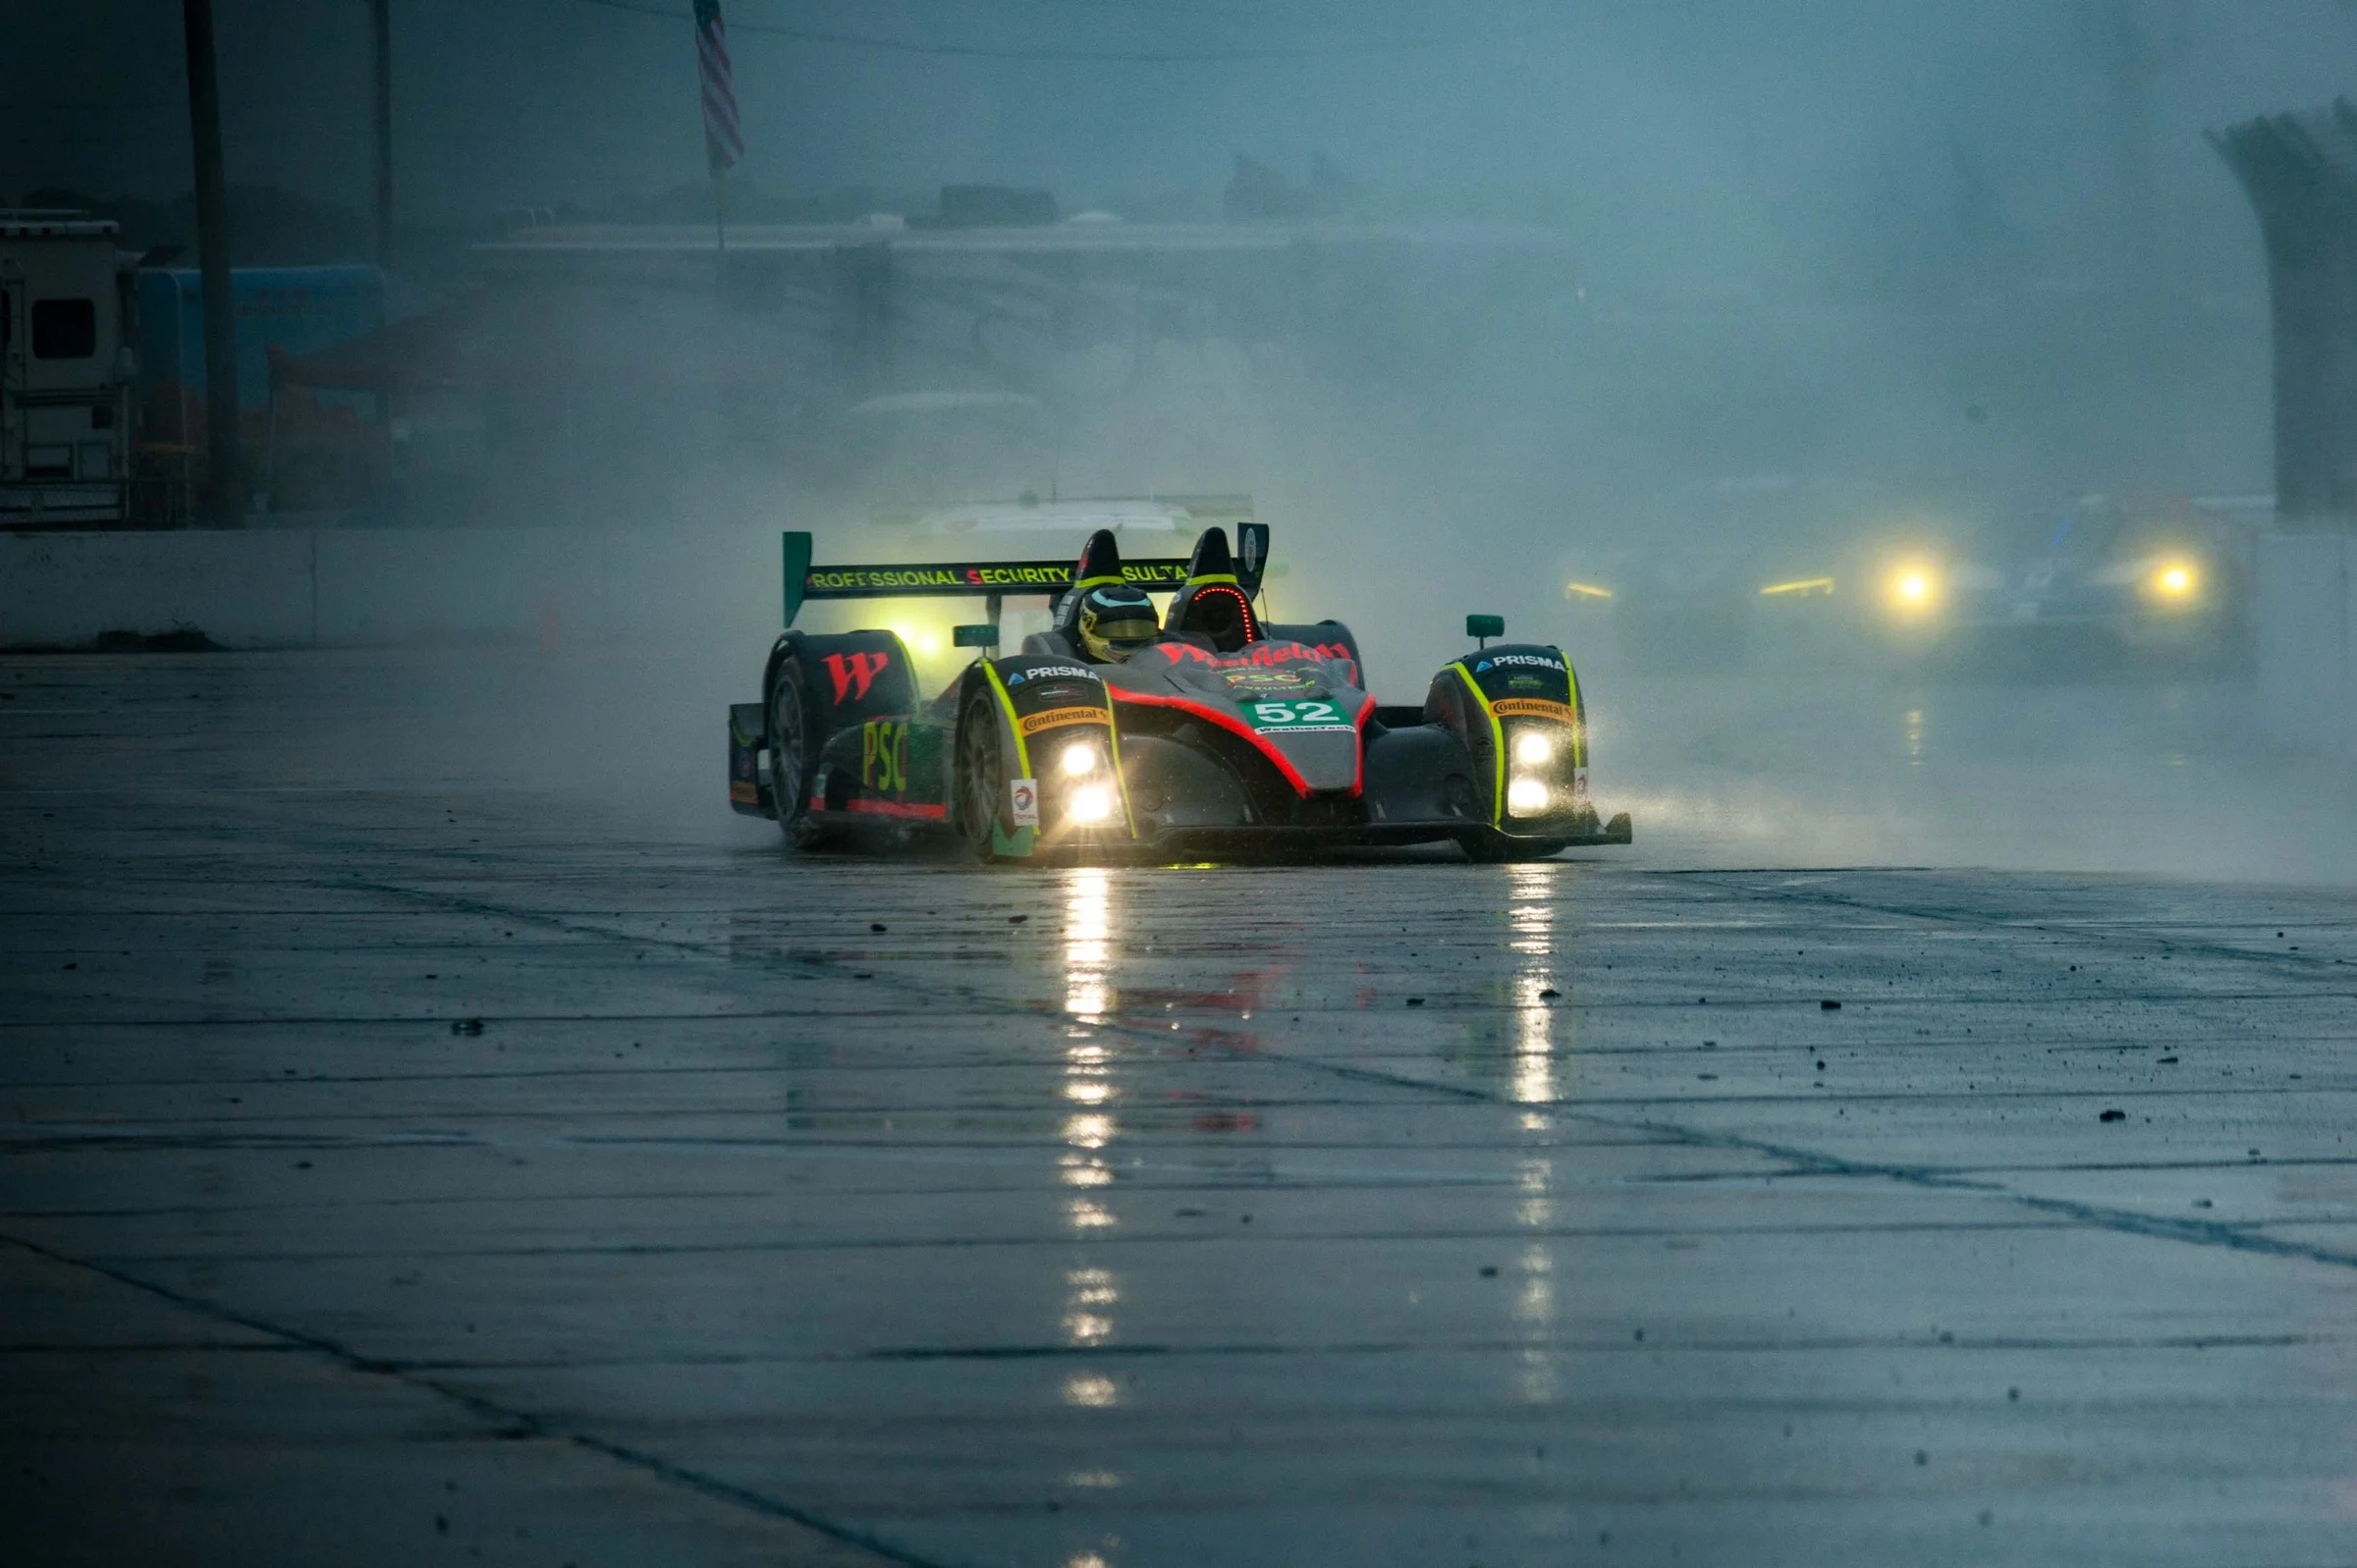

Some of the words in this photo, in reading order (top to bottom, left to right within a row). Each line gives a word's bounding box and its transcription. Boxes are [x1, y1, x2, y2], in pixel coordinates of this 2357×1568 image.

[966, 568, 1069, 584] SECURITY
[1493, 655, 1566, 673] PRISMA
[1025, 667, 1100, 681] PRISMA
[1255, 702, 1341, 723] 52
[1493, 700, 1563, 715] Continental
[1023, 709, 1097, 731] Continental
[1259, 725, 1354, 733] WeatherTech
[863, 721, 908, 791] PSC
